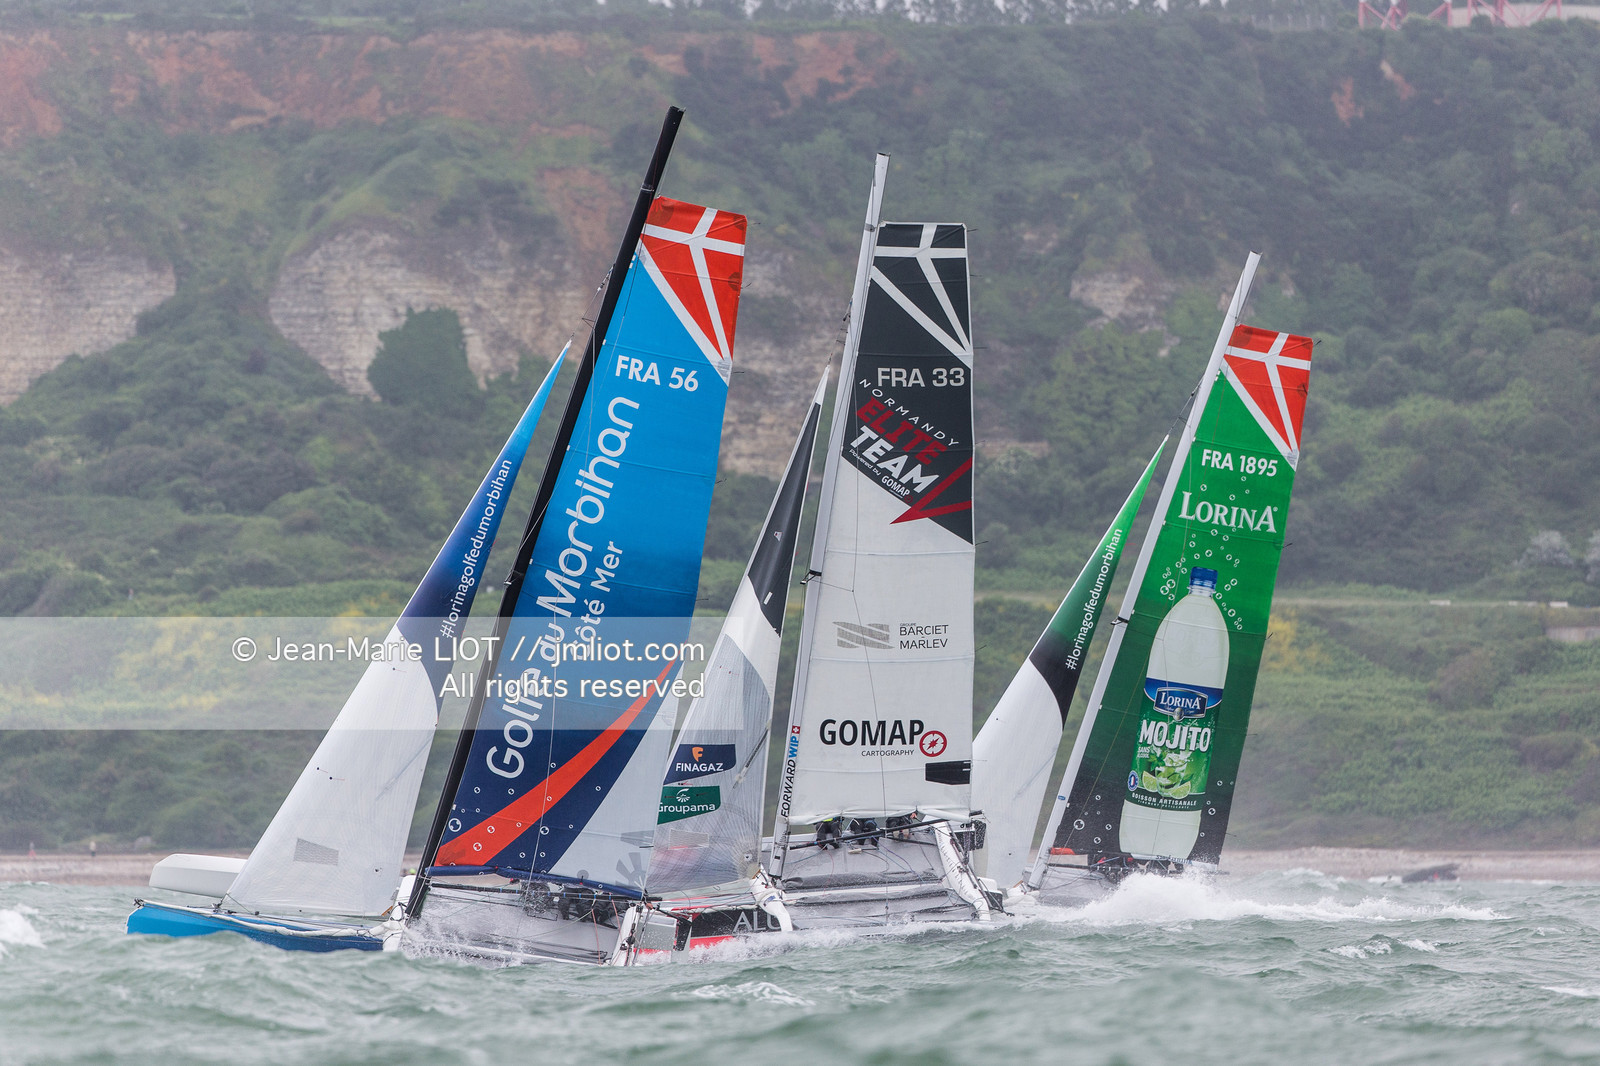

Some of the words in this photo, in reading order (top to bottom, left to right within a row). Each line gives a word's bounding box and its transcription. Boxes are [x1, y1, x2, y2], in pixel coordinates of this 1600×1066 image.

[615, 354, 661, 386] FRA
[668, 366, 699, 392] 56
[877, 367, 926, 388] FRA
[932, 367, 965, 387] 33
[859, 378, 959, 447] NORMANDY
[856, 396, 948, 466] ELITE
[850, 425, 939, 494] TEAM
[1201, 448, 1234, 472] FRA
[1239, 454, 1278, 477] 1895
[881, 475, 911, 497] GOMAP
[535, 396, 640, 619] Morbihan
[439, 459, 513, 639] #lorinagolfedumorbihan
[590, 540, 623, 593] Mer
[1065, 528, 1123, 671] #lorinagolfedumorbihan
[540, 622, 565, 662] du
[899, 624, 949, 636] BARCIET
[899, 638, 948, 650] MARLEV
[819, 718, 925, 746] GOMAP
[1138, 719, 1211, 753] MOJITO
[675, 762, 724, 772] FINAGAZ
[861, 749, 915, 757] CARTOGRAPHY
[1131, 792, 1157, 803] BOISSON
[1159, 798, 1197, 806] ARTISANALE
